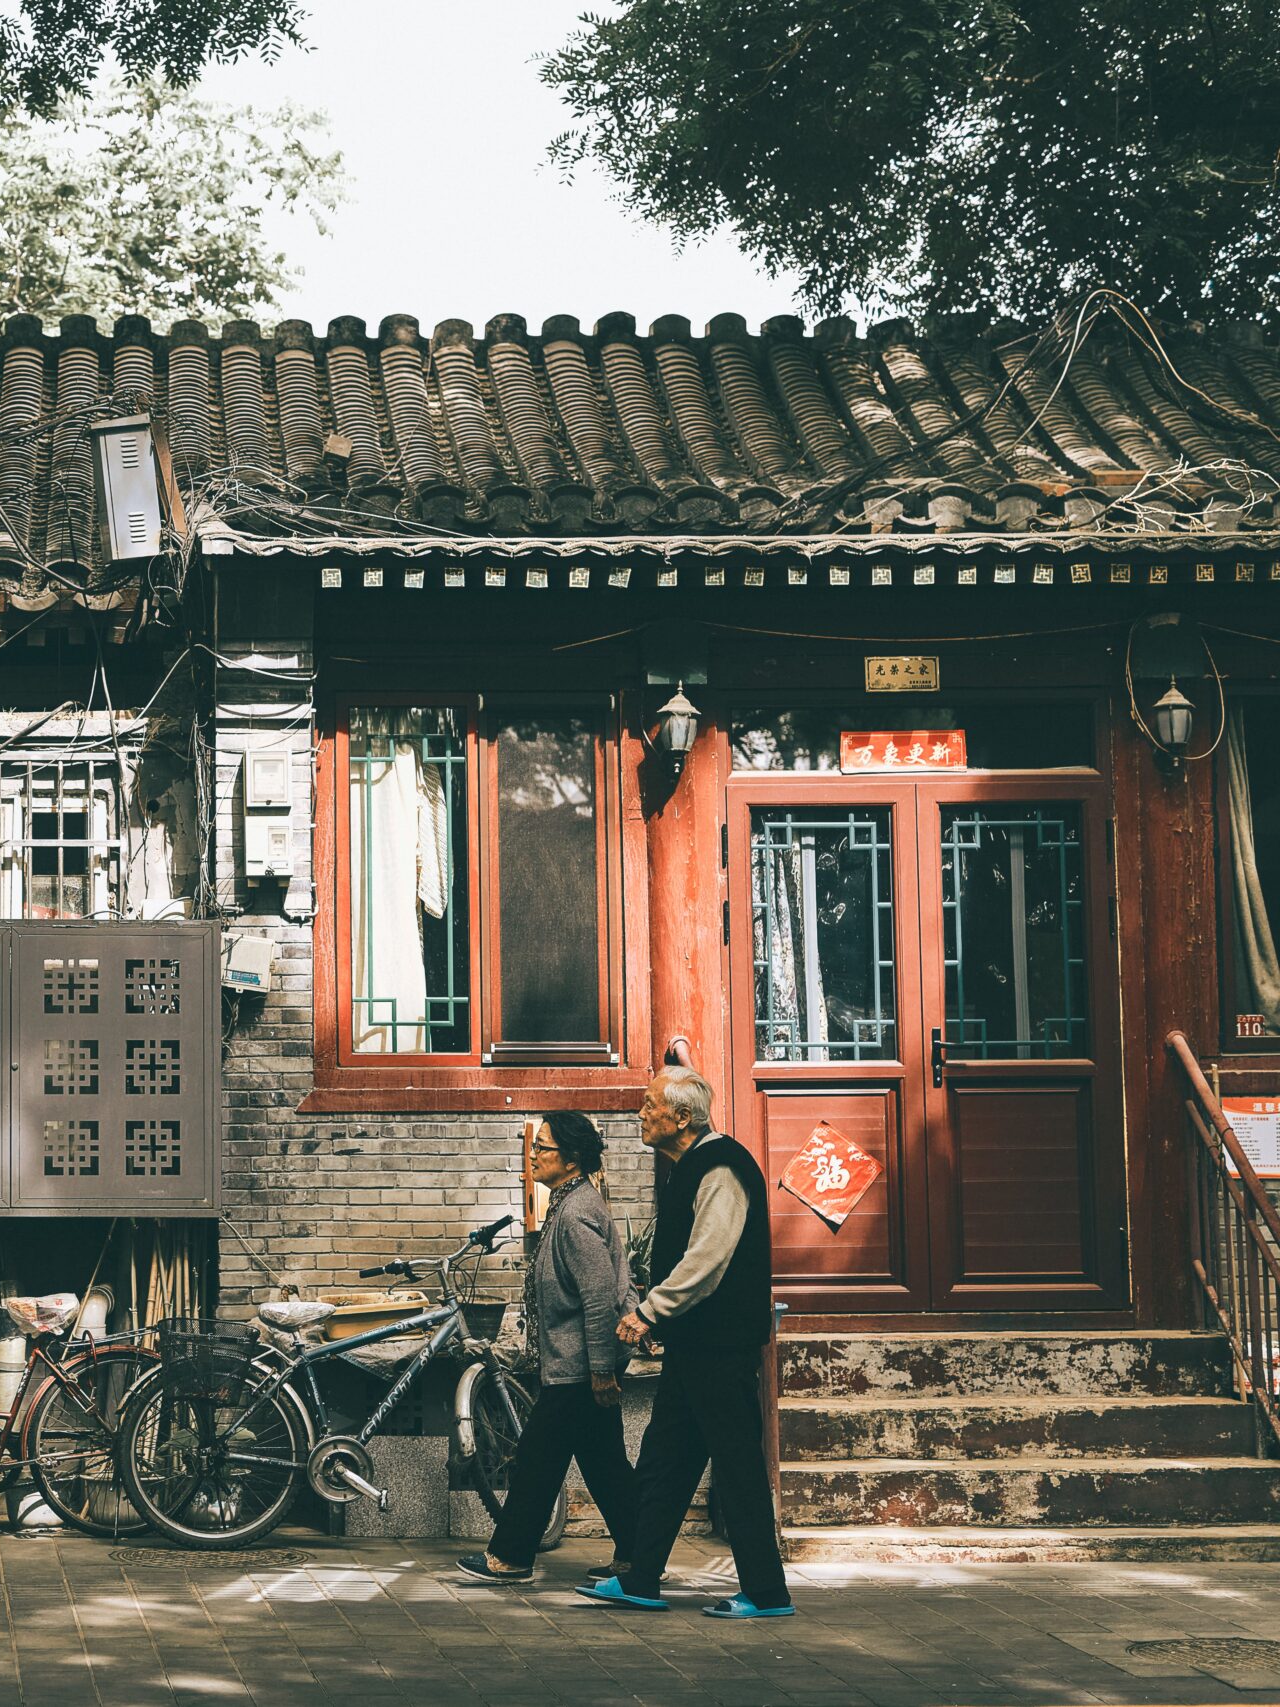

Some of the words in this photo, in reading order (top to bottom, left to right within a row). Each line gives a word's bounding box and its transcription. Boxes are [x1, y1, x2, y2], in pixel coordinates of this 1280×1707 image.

[875, 663, 929, 676] 光荣之家
[853, 740, 952, 766] 万象更新
[1236, 1022, 1261, 1036] 110
[810, 1154, 851, 1193] 福
[361, 1371, 412, 1441] GIANT
